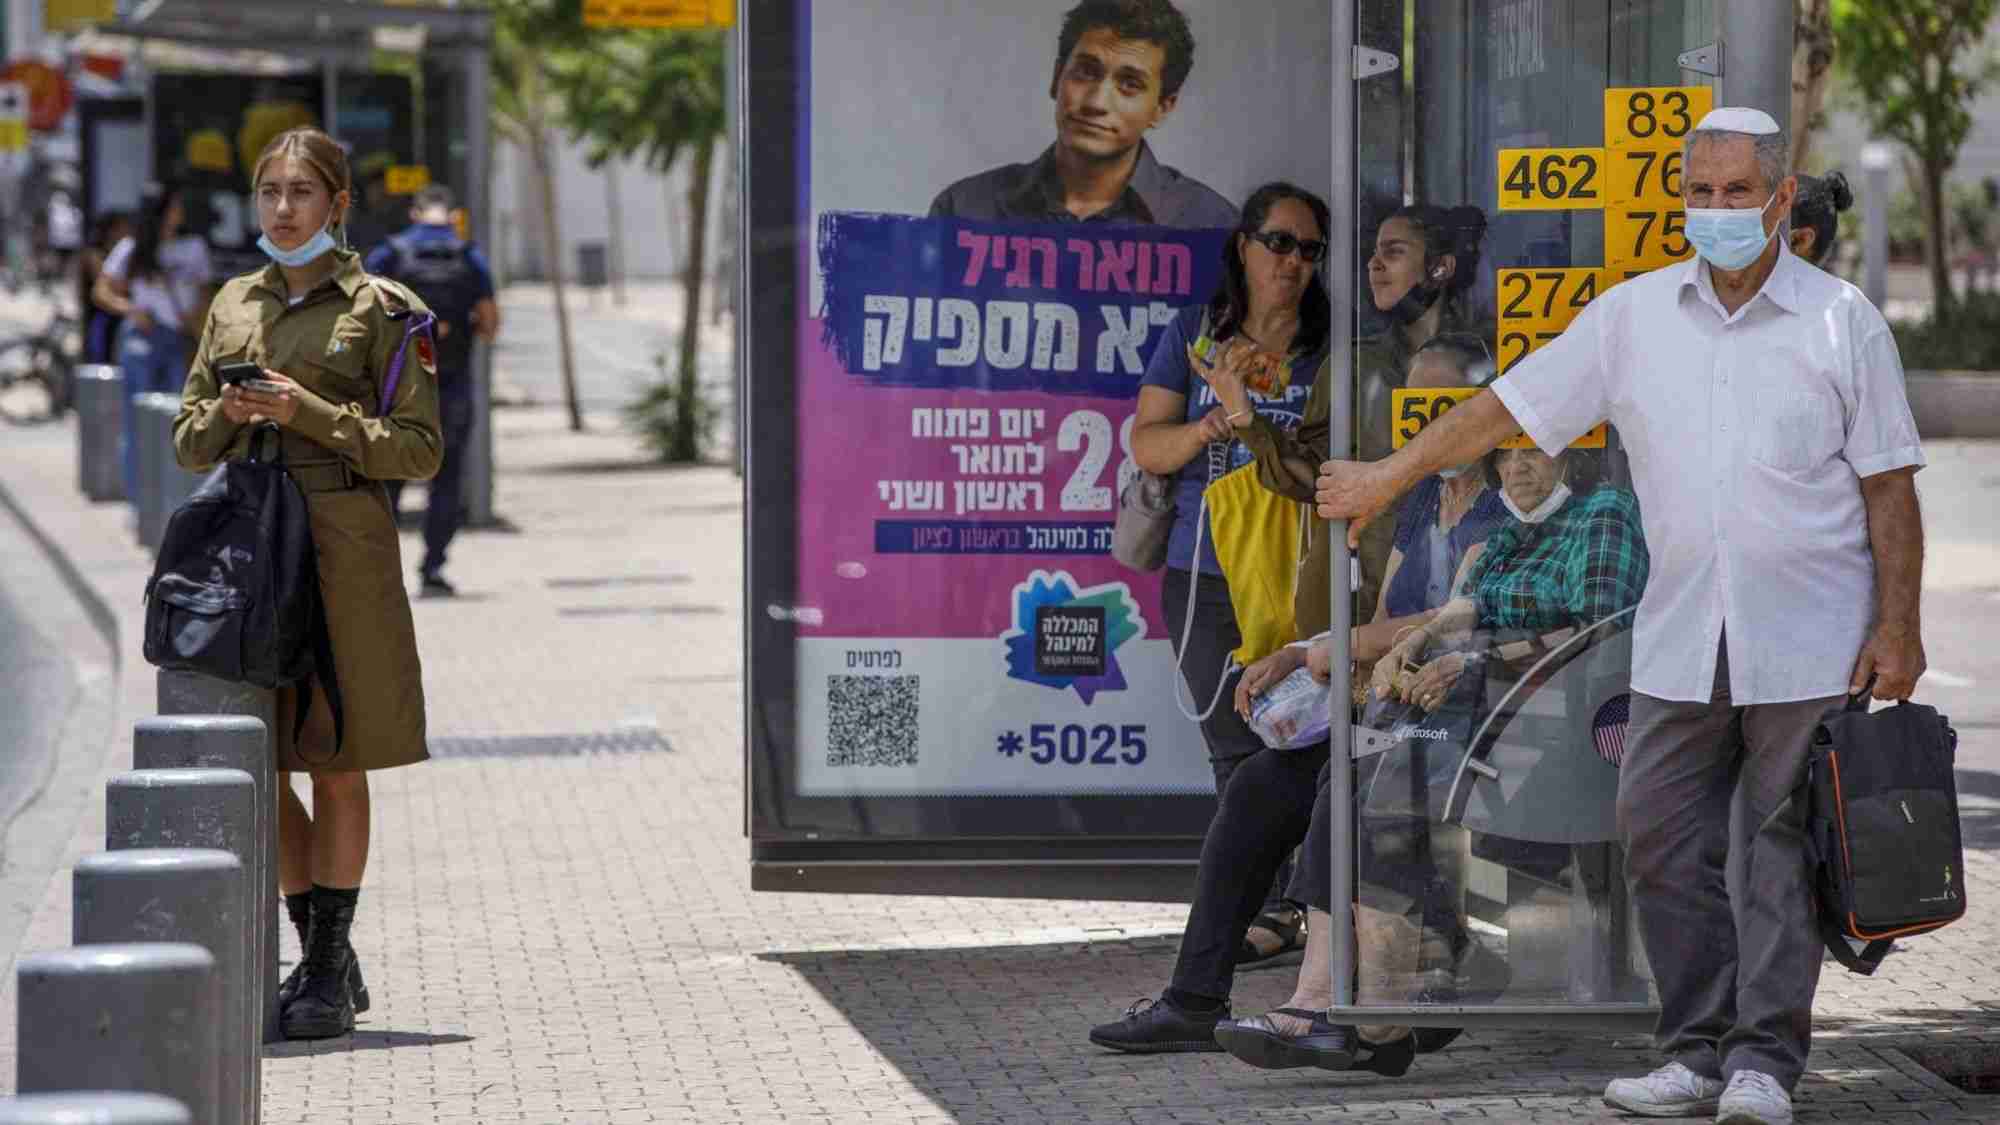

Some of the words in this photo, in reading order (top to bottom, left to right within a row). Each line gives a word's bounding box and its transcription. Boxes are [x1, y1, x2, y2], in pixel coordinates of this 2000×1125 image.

[1627, 91, 1691, 138] 83
[1503, 154, 1598, 199] 462
[1627, 152, 1683, 198] 76
[1626, 211, 1691, 257] 75
[957, 229, 1058, 288] רגיל
[1066, 238, 1192, 295] תואר
[1502, 272, 1596, 318] 274
[863, 294, 1080, 371] מספיק
[911, 408, 990, 438] פתוח
[998, 408, 1046, 438] יום
[951, 442, 1046, 475] לתואר
[877, 480, 945, 511] ושני
[953, 480, 1044, 515] ראשון
[912, 525, 953, 552] לציון
[959, 526, 1021, 552] בראשון
[1026, 525, 1087, 550] למינהל
[1042, 615, 1099, 633] המכללה
[845, 649, 902, 668] לפרטים
[1045, 634, 1097, 652] למינהל
